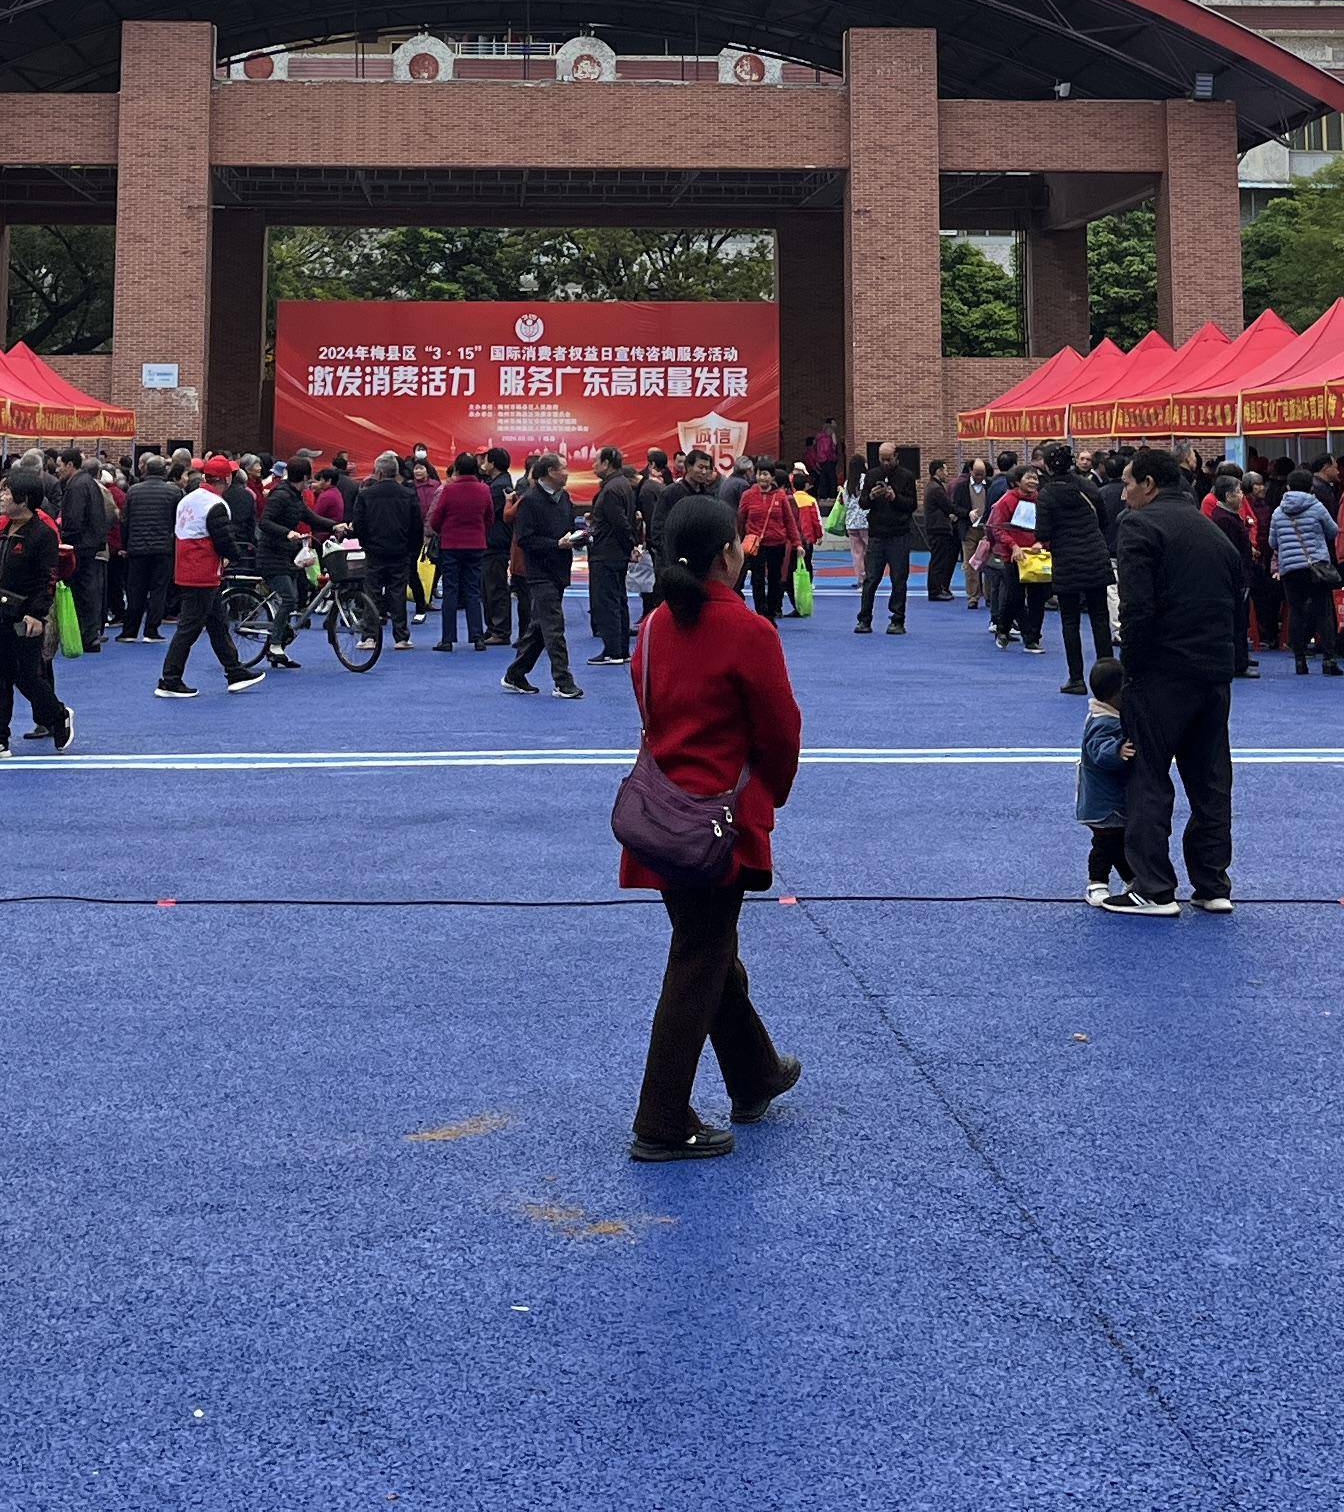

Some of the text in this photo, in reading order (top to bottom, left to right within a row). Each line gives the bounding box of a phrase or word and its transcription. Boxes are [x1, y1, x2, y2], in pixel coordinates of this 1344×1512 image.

[308, 365, 749, 399] 激发消费活力 服务广东高质量发展
[695, 427, 731, 444] 诚信
